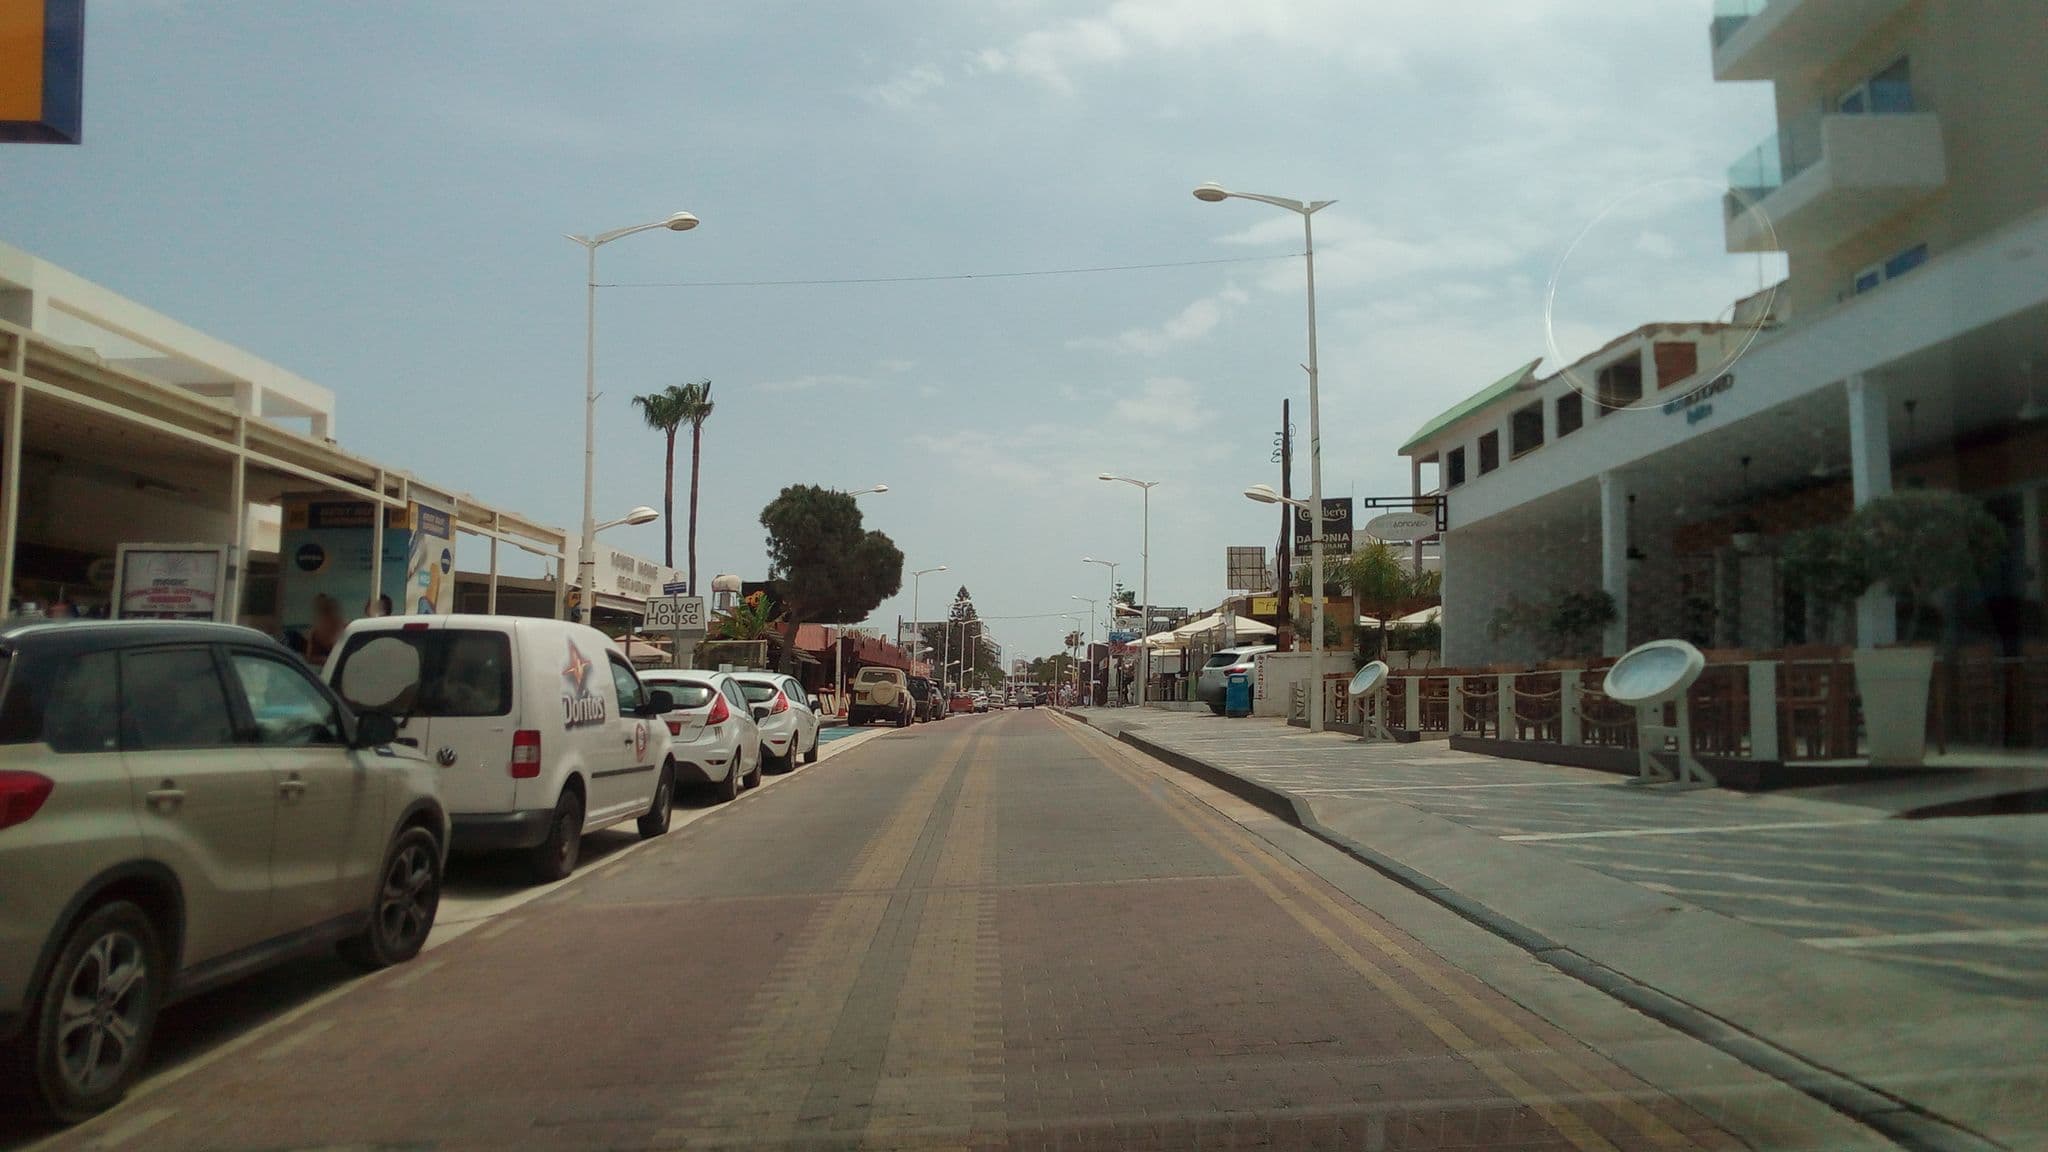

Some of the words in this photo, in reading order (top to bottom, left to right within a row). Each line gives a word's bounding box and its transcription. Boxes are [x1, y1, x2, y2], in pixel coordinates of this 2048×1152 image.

[1298, 506, 1347, 521] Caberg
[648, 600, 701, 613] Tower
[646, 612, 698, 625] House
[563, 690, 605, 725] Doritos
